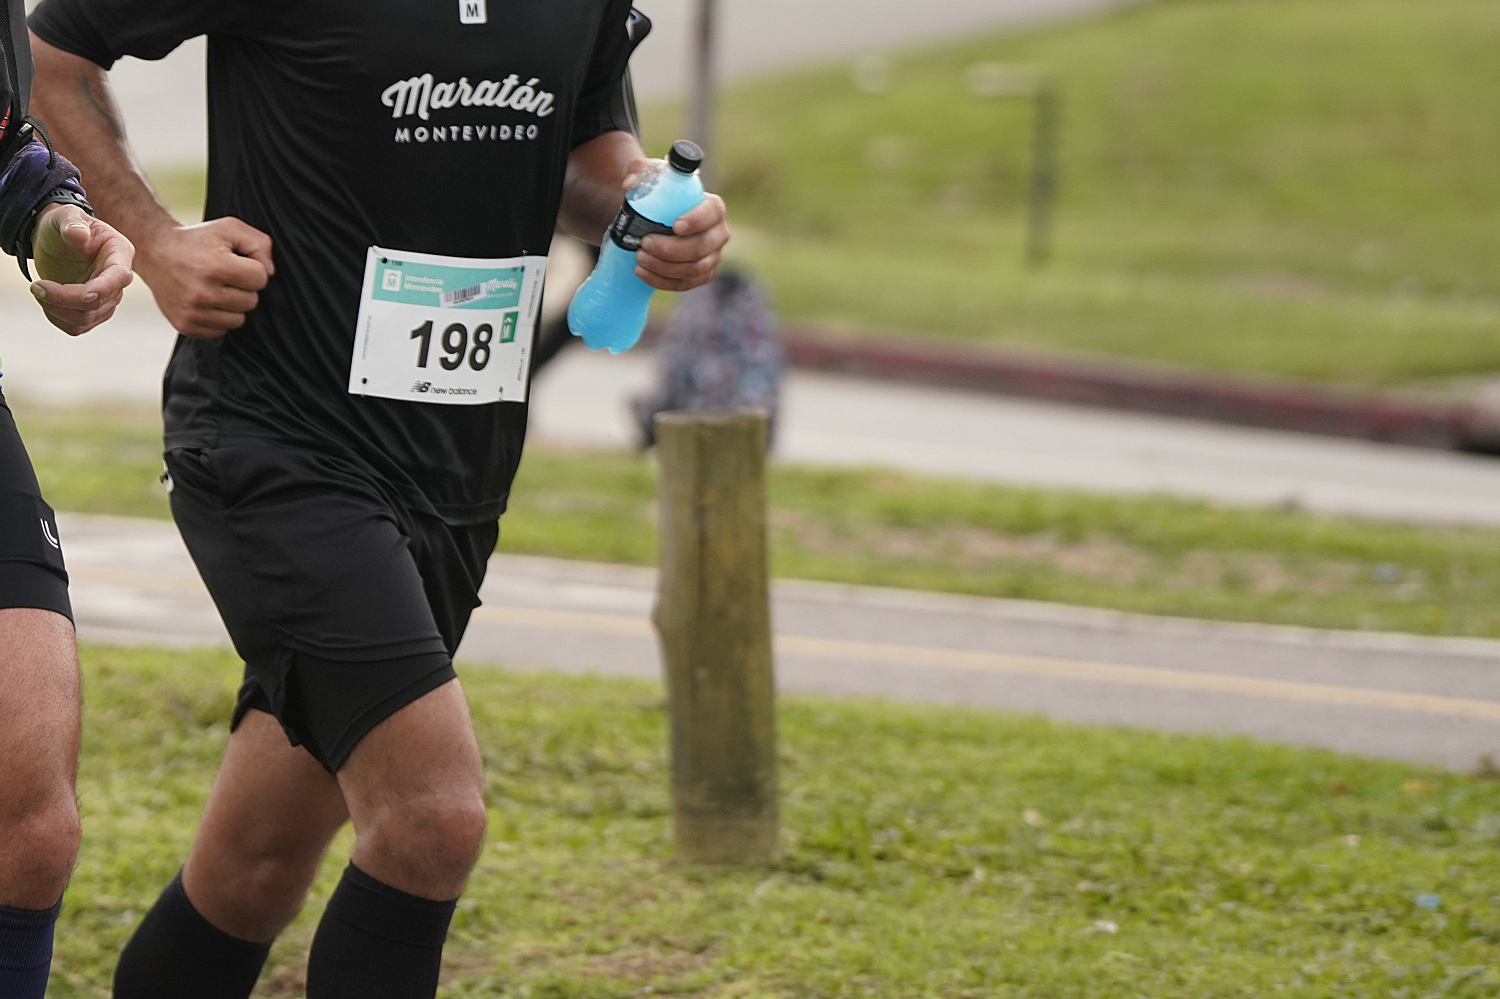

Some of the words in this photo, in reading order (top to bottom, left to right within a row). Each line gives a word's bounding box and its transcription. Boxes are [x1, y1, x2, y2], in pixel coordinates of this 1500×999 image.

[381, 73, 555, 121] Maratón
[394, 124, 539, 144] MONTEVIDEO
[404, 274, 444, 285] Intendencia
[409, 320, 493, 371] 198
[449, 386, 477, 395] balance
